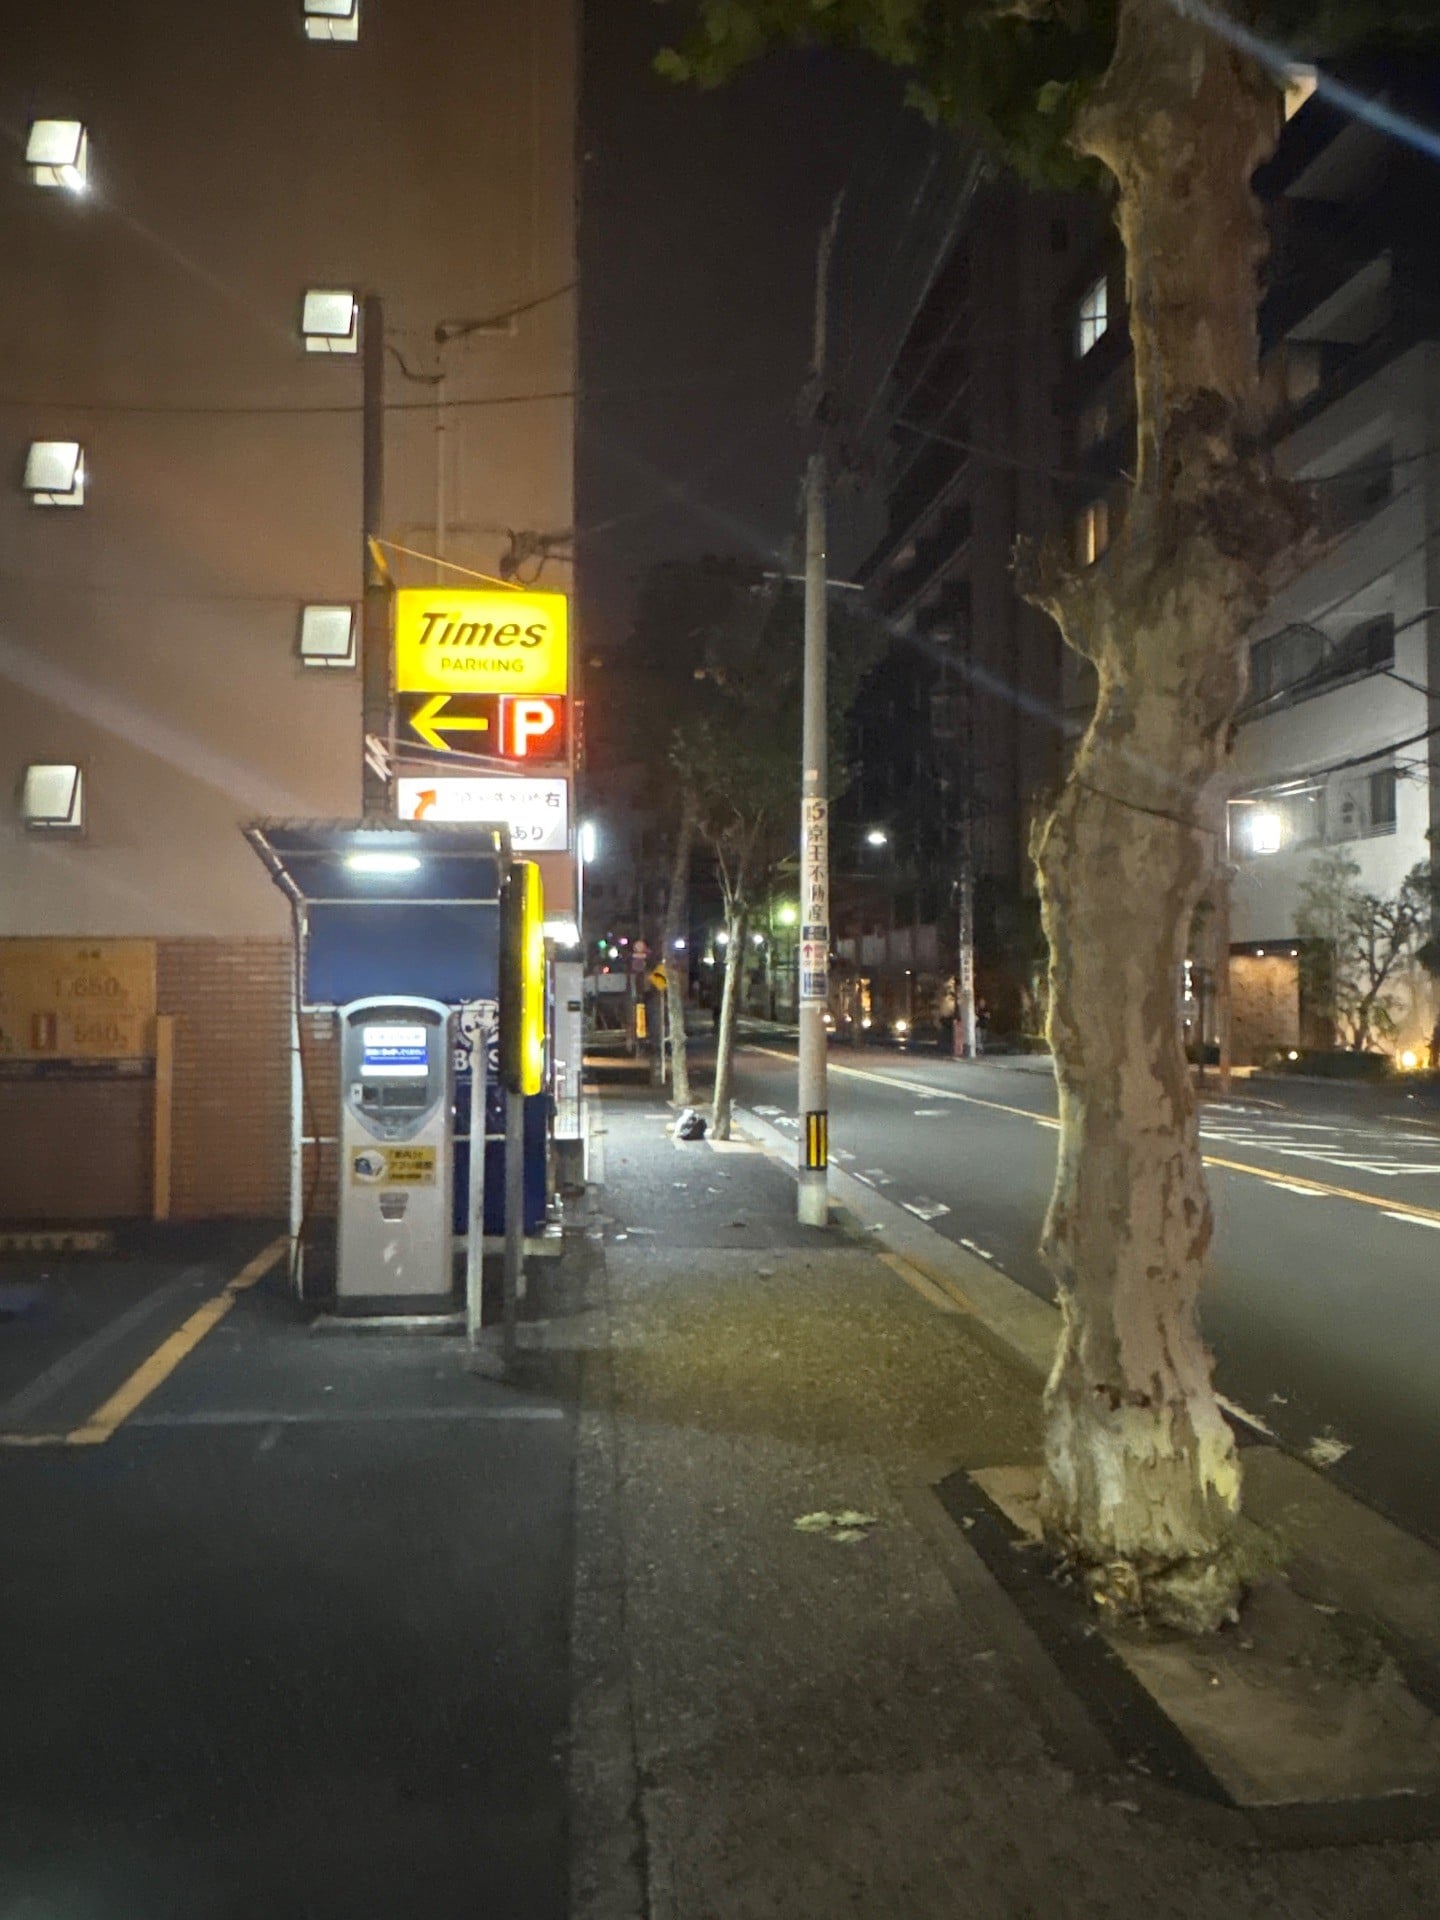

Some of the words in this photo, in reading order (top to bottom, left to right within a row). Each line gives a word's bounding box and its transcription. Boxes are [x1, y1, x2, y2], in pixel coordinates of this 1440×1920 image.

[420, 612, 547, 648] Times
[441, 658, 524, 672] PARKING
[513, 701, 554, 756] P
